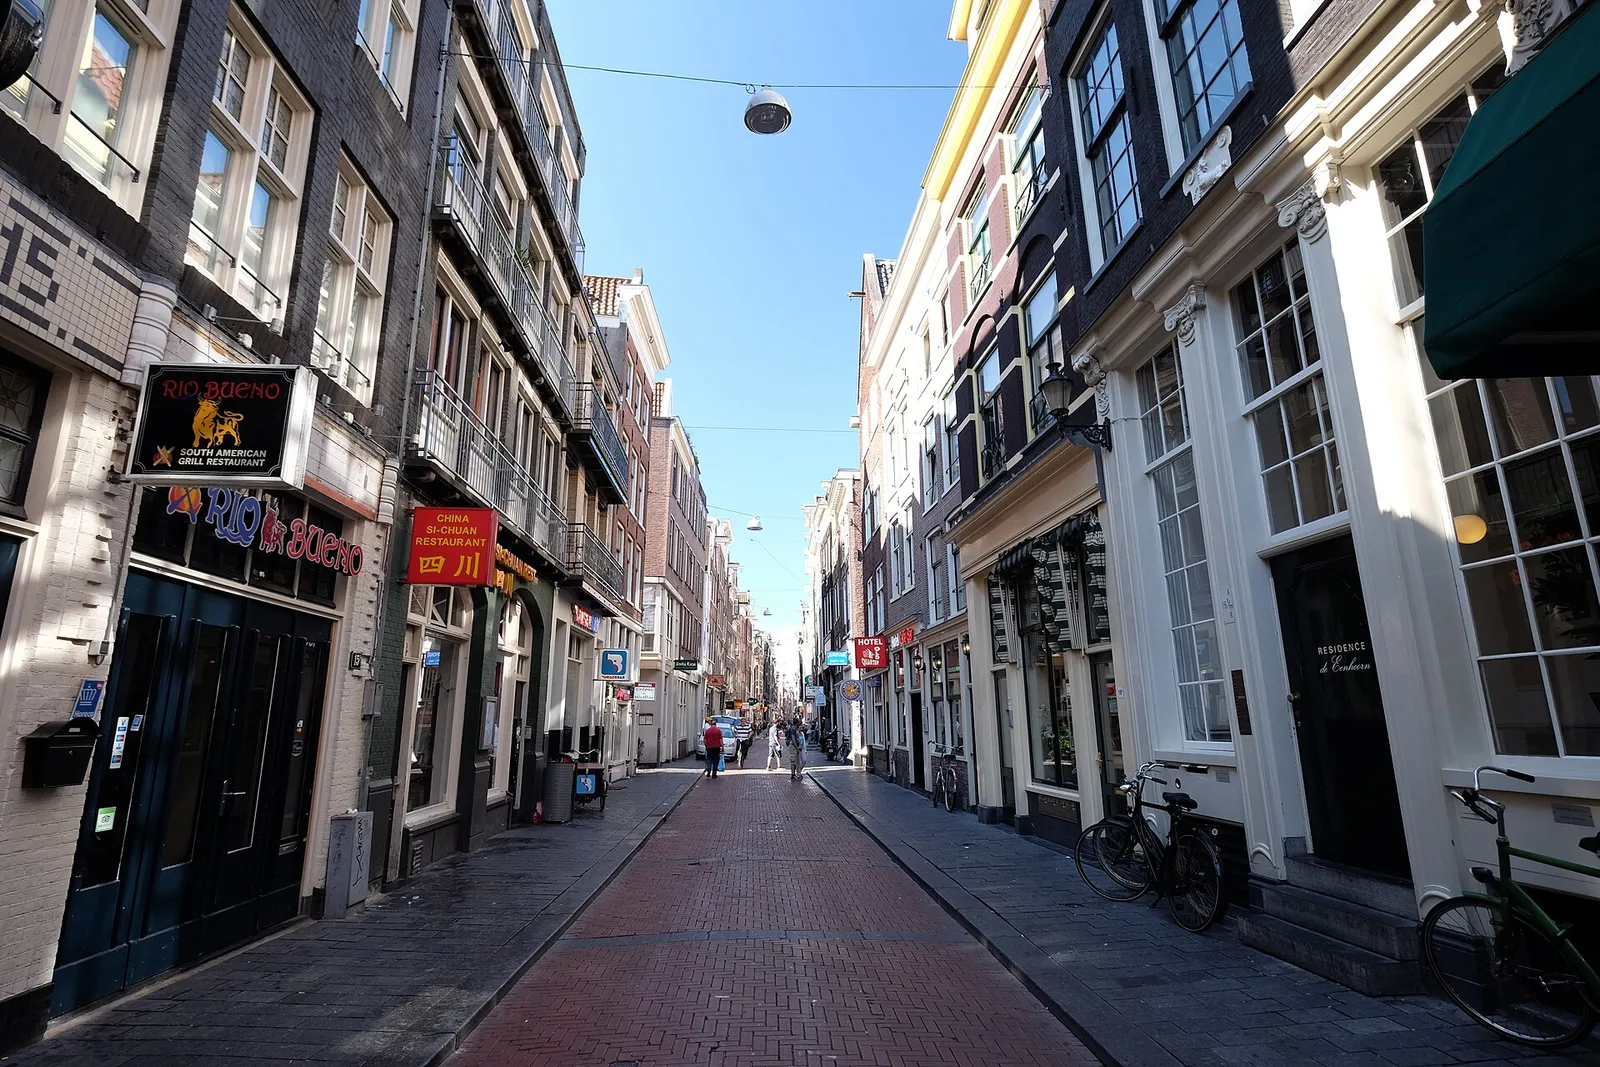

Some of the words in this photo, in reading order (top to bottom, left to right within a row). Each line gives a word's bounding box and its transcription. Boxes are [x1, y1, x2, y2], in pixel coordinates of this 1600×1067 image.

[162, 380, 199, 397] RIO
[204, 381, 280, 399] BUENO
[180, 448, 213, 457] SOUTH
[216, 449, 267, 458] AMERICAN
[178, 457, 204, 466] GRILL
[206, 457, 265, 467] RESTAURANT
[437, 514, 469, 523] CHINA
[205, 487, 262, 547] RIO
[286, 518, 364, 577] BUENO
[426, 526, 477, 535] SI-CHUAN
[415, 537, 487, 547] RESTAURANT
[419, 552, 481, 579] 四川
[858, 638, 883, 646] HOTEL
[1317, 641, 1366, 655] RESIDENCE
[1320, 662, 1328, 673] de
